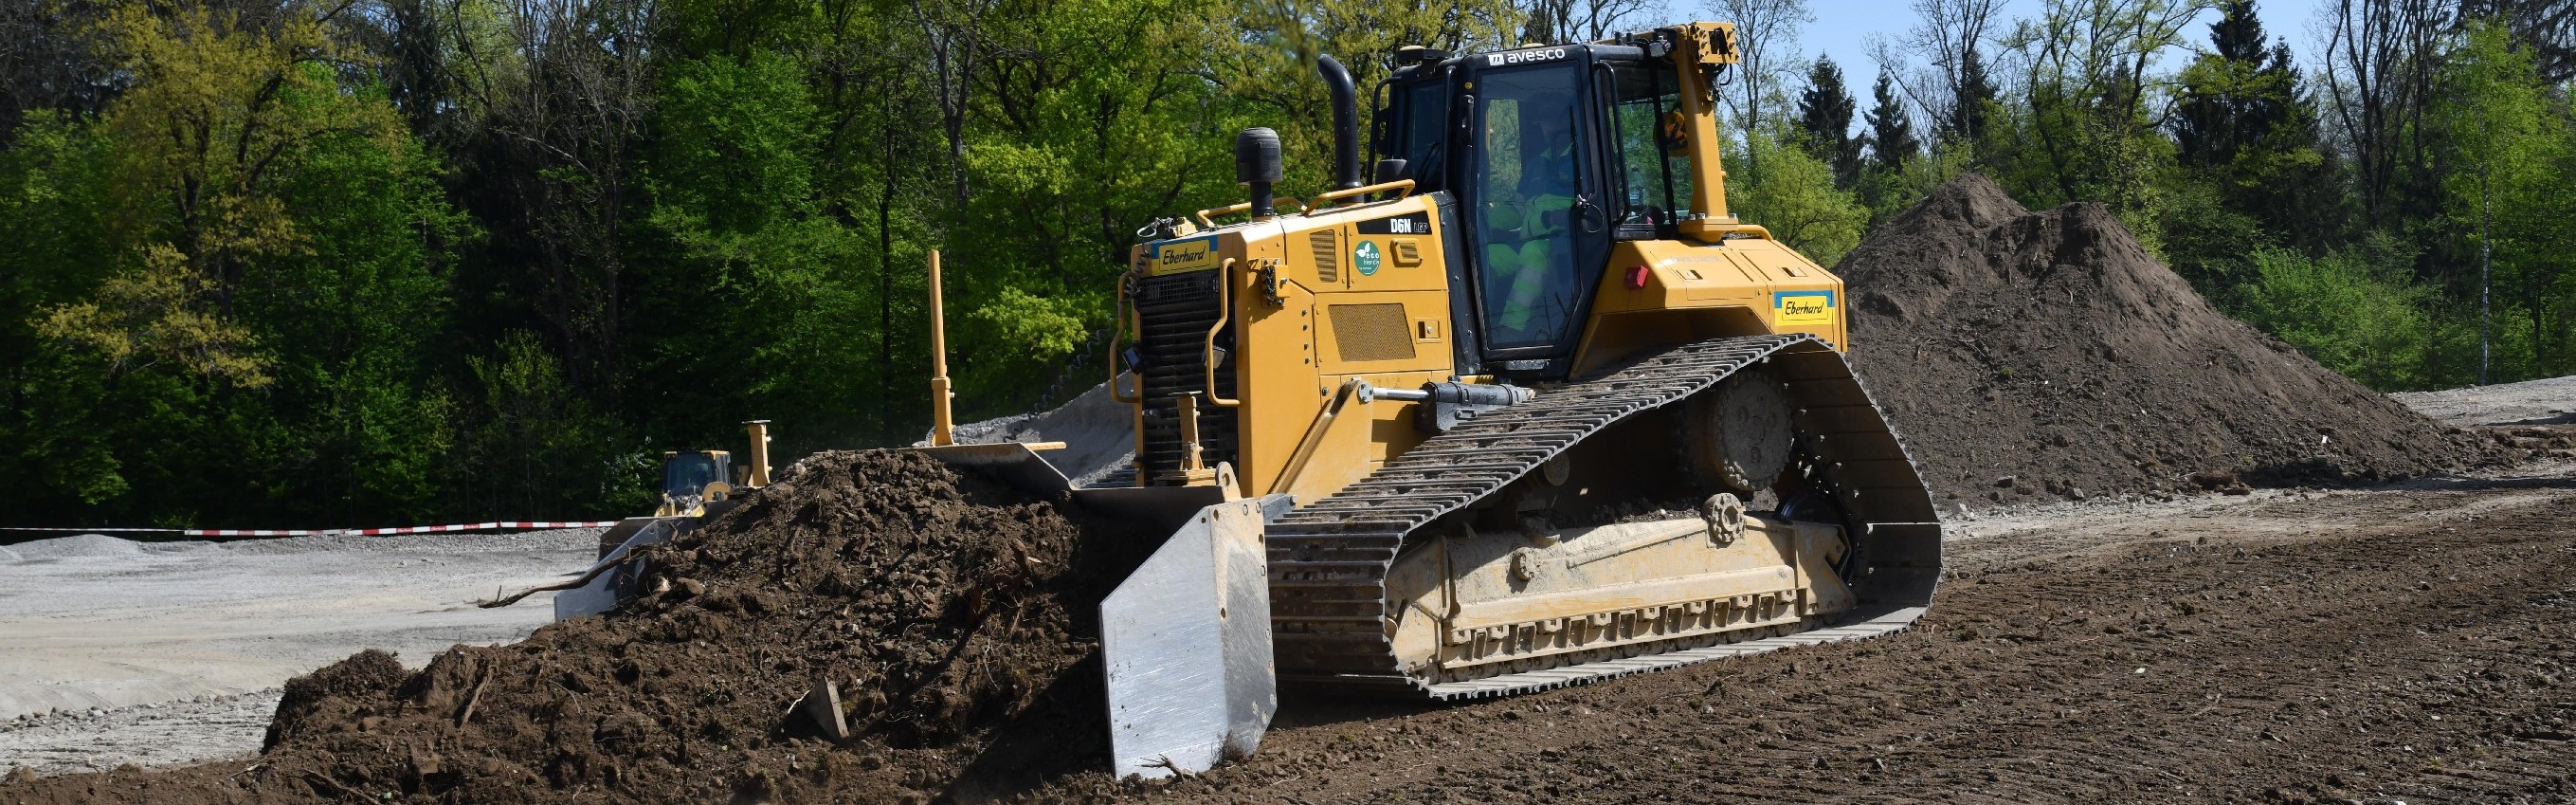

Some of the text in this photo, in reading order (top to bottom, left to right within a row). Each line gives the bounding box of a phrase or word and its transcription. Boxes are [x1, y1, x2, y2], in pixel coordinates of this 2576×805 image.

[1507, 48, 1566, 64] avesco
[1390, 218, 1412, 233] D6N
[1164, 246, 1206, 265] Eberhard
[1785, 301, 1824, 315] Eberhard
